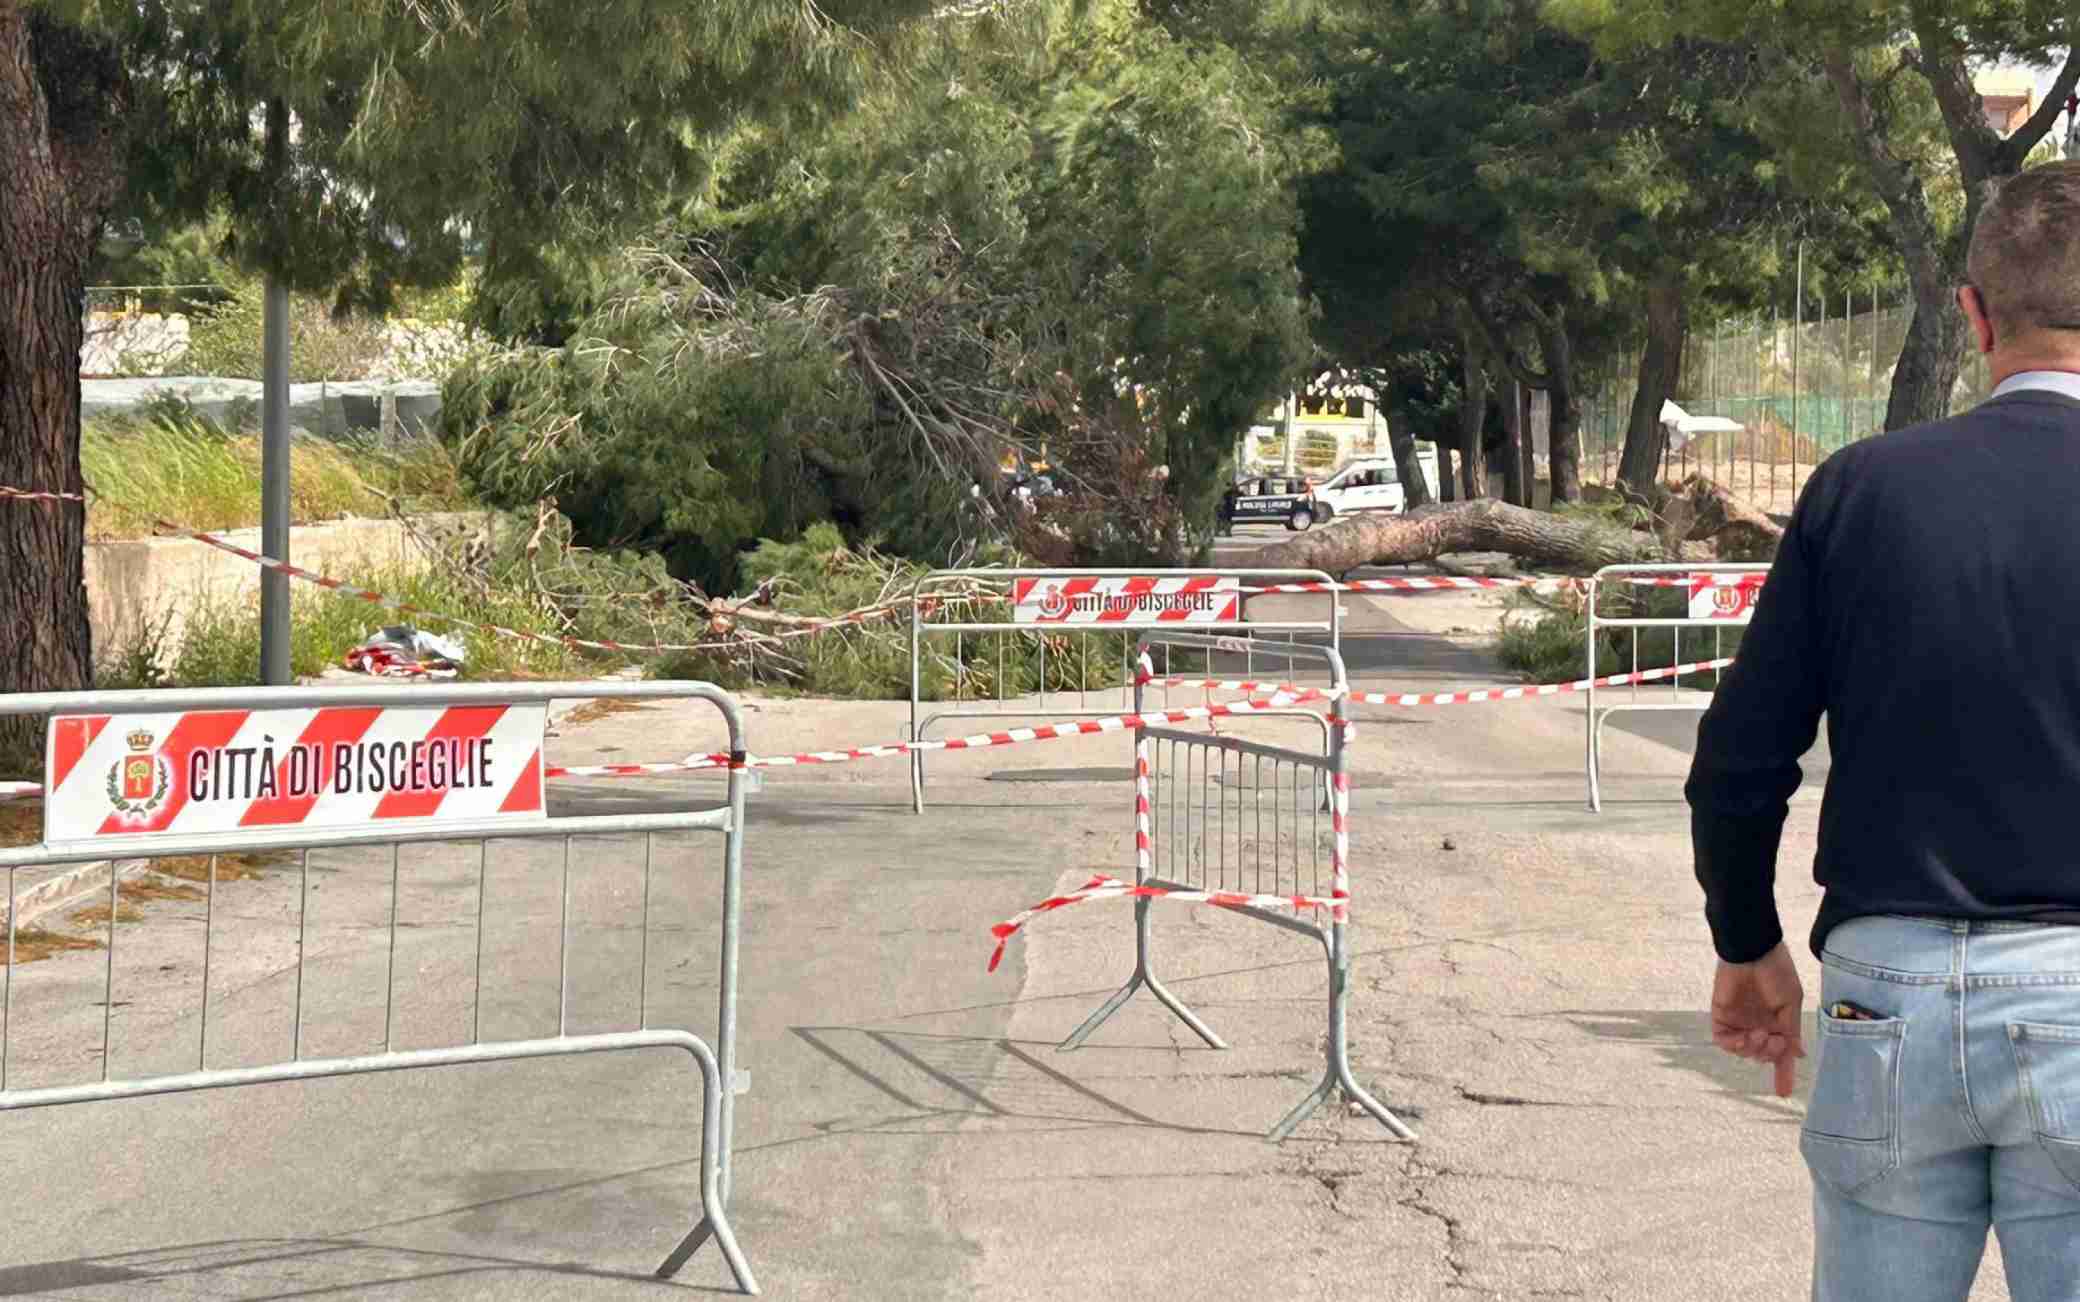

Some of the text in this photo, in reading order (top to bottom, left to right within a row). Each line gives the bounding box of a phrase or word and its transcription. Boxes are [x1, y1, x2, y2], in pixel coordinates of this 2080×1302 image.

[190, 734, 494, 802] CITTÀ DI BISCEGLIE
